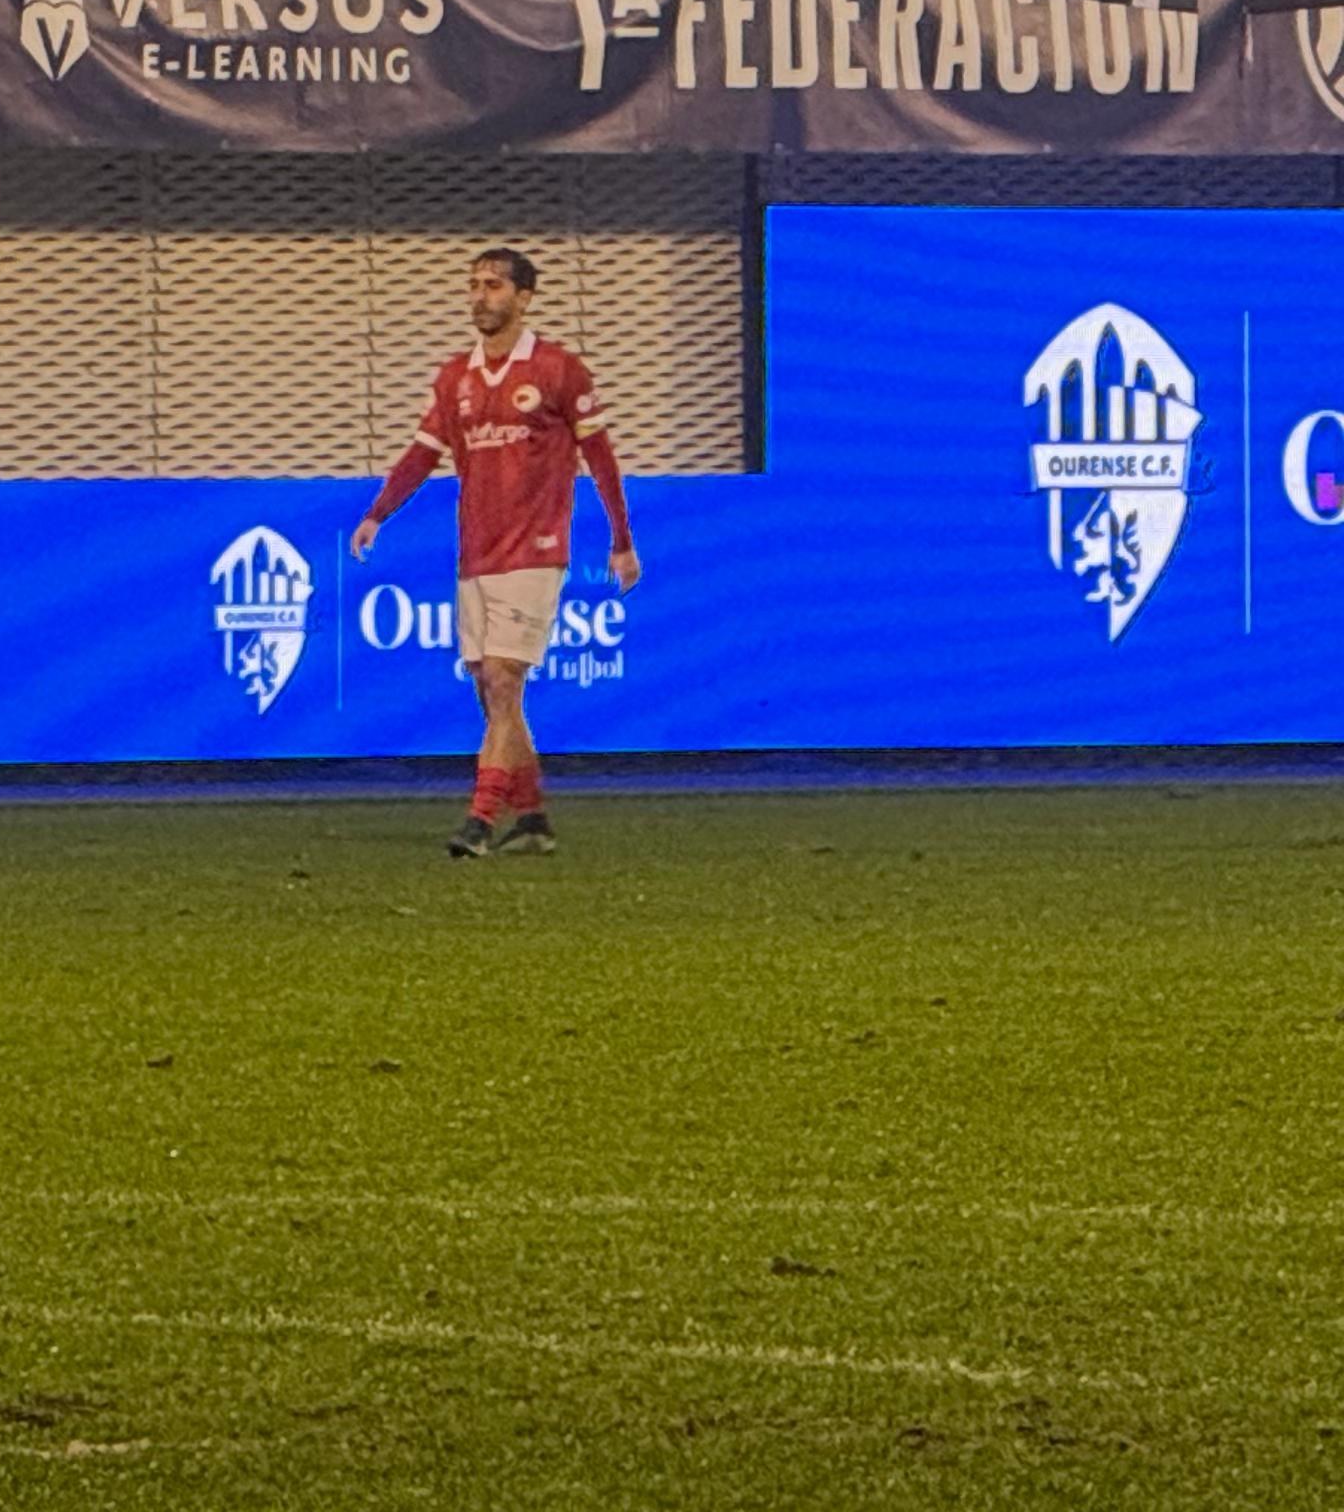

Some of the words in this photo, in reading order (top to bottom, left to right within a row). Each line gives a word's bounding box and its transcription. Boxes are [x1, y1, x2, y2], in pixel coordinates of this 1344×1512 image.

[142, 44, 412, 84] E-LEARNING
[1048, 455, 1137, 477] OURENSE
[1141, 455, 1177, 477] C.F.
[359, 584, 626, 650] Ouse
